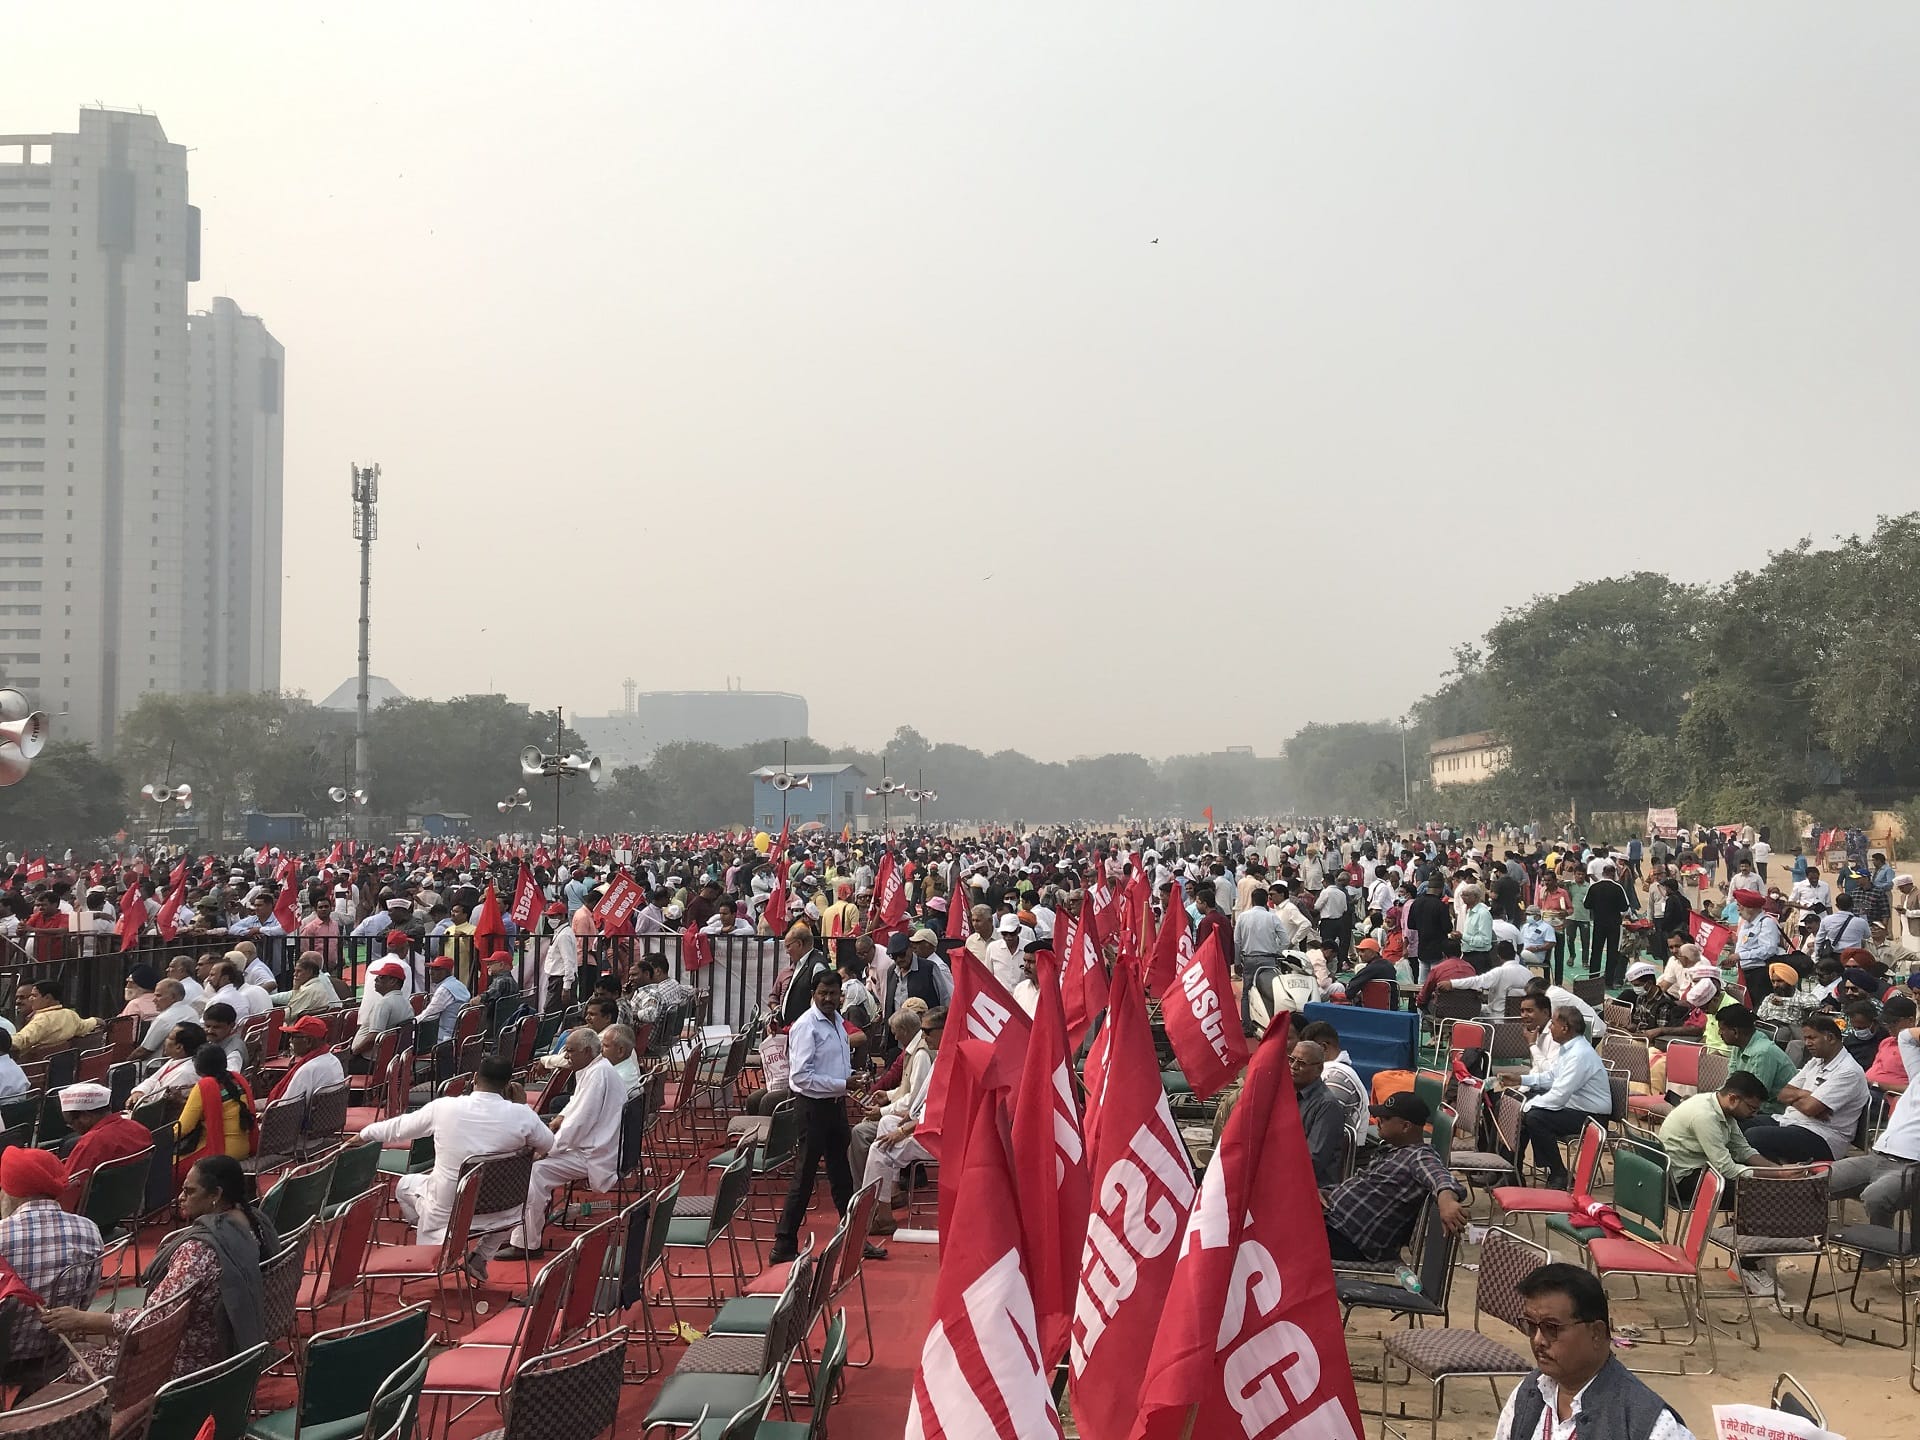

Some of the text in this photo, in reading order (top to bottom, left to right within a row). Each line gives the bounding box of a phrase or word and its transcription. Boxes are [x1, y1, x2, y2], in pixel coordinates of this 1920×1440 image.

[1726, 1417, 1740, 1432] मेरे
[1740, 1420, 1754, 1434] वोट
[1757, 1424, 1766, 1437] से
